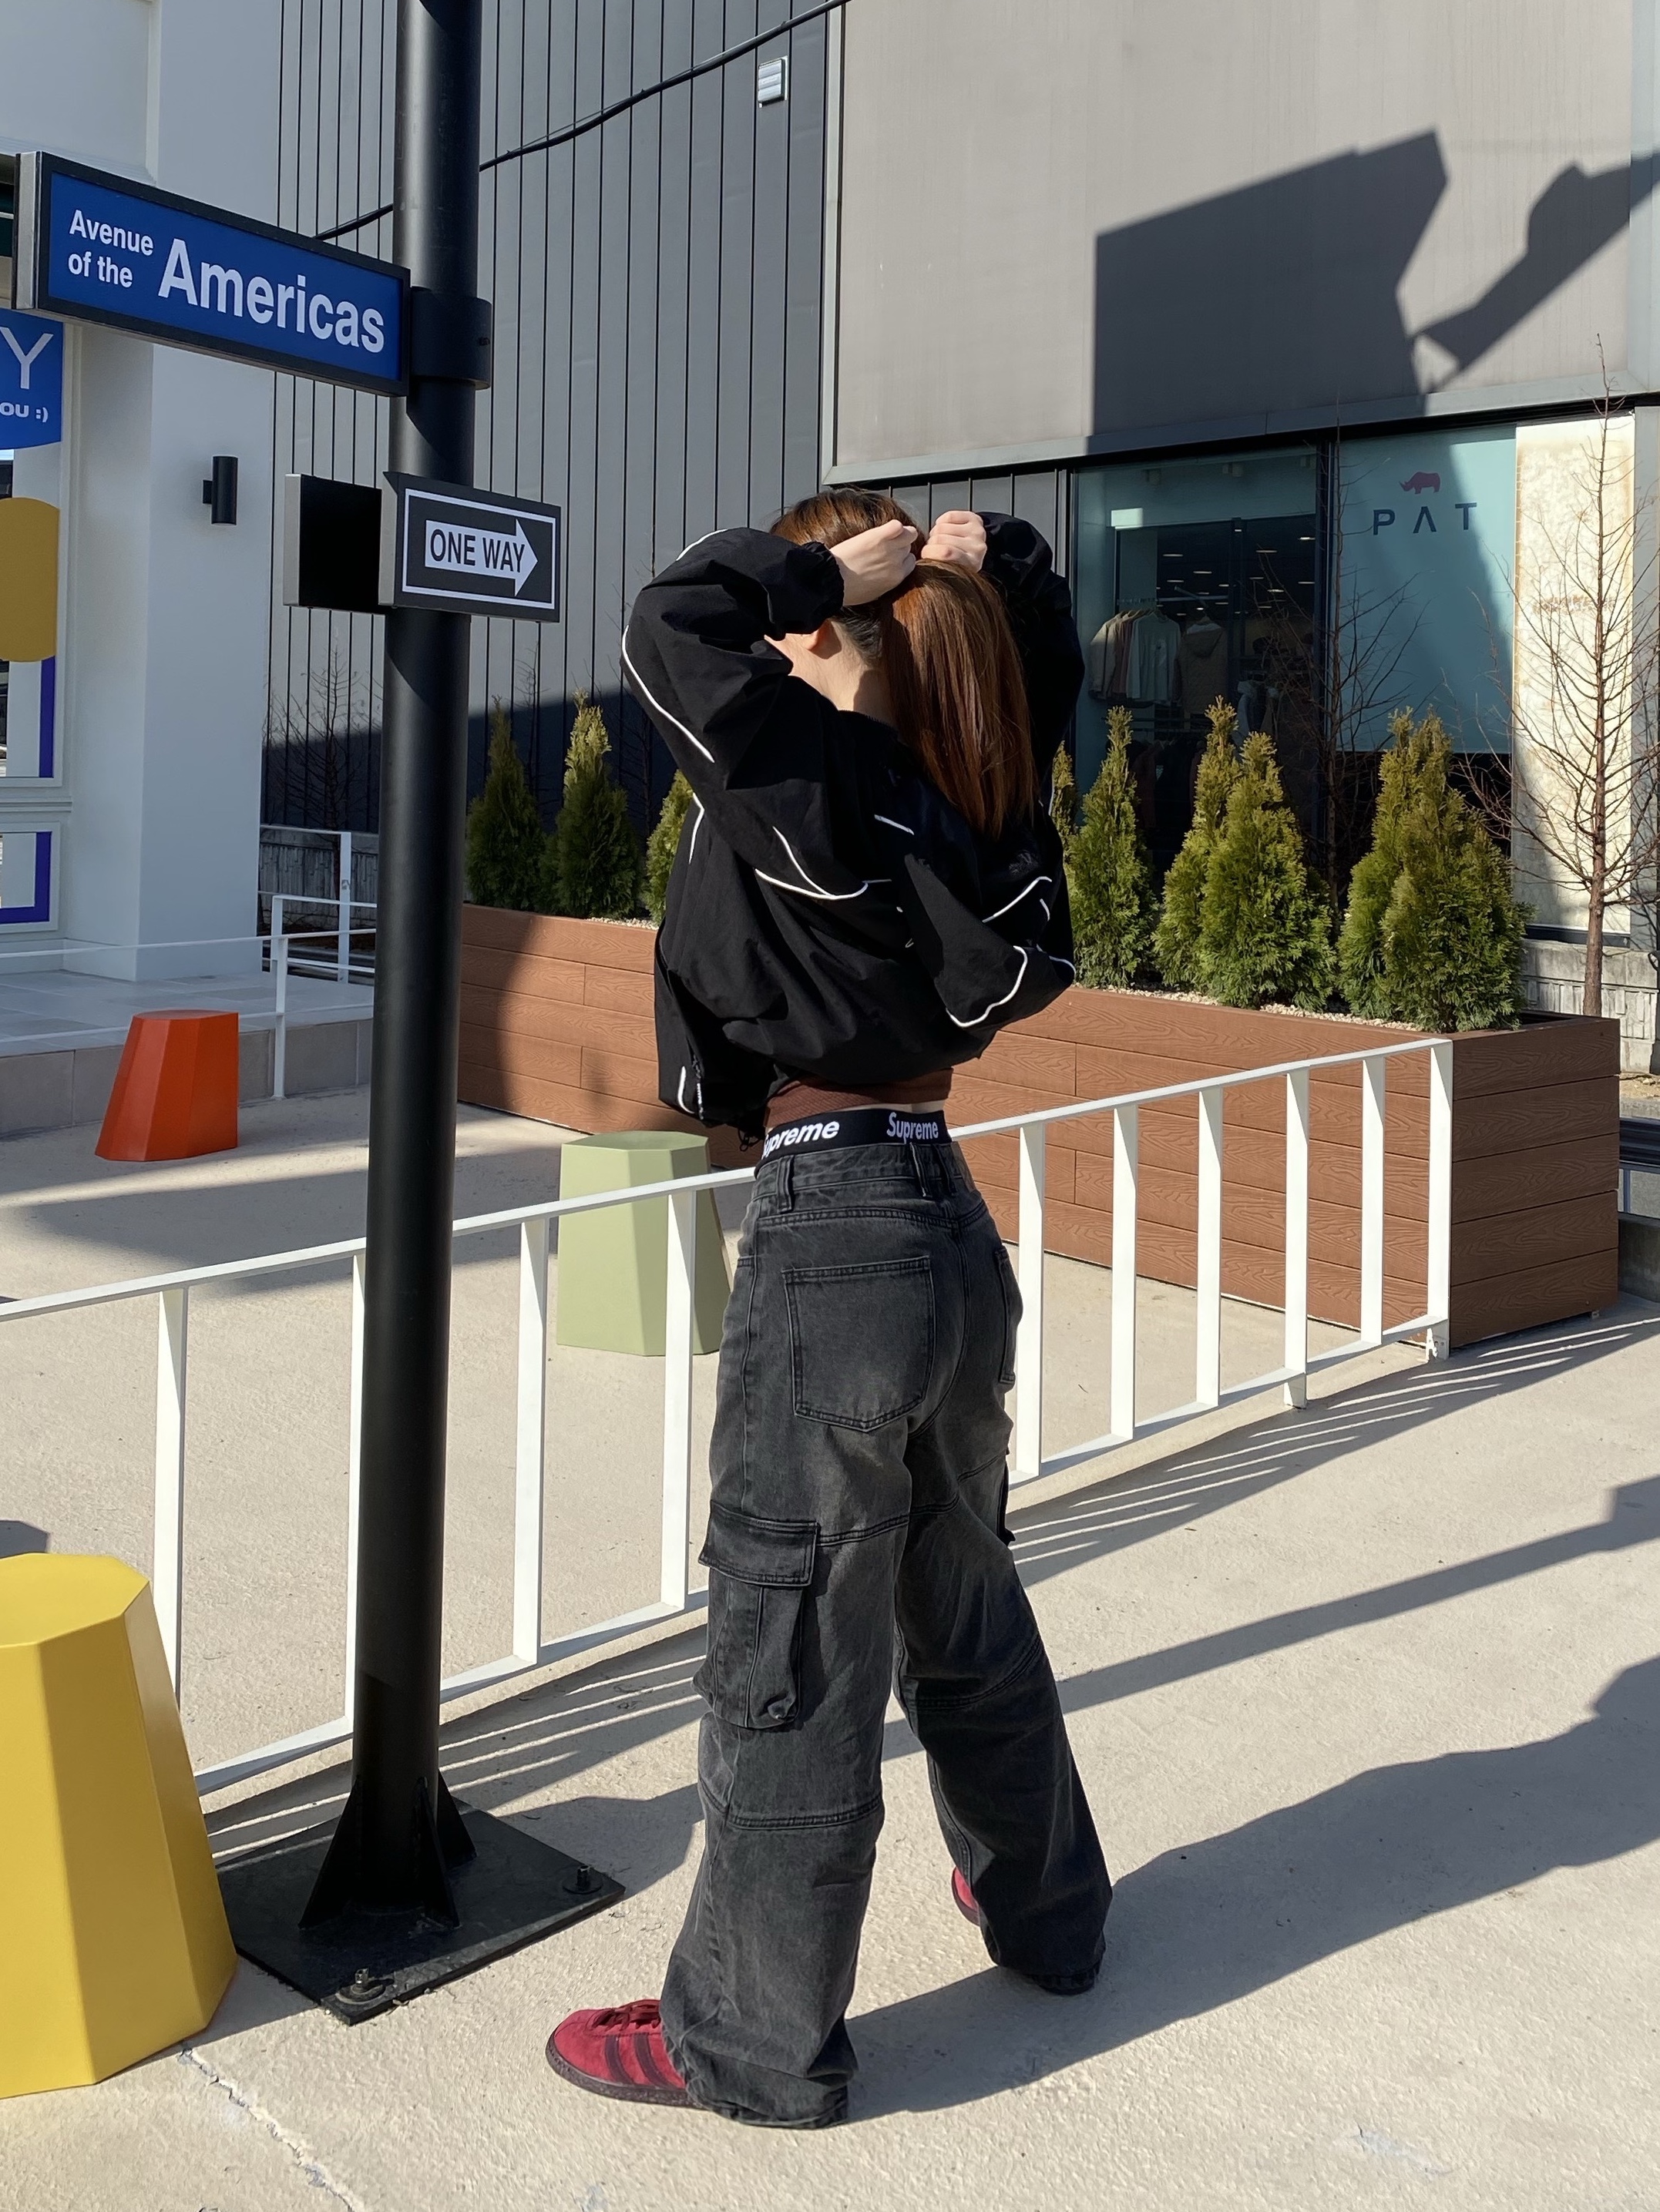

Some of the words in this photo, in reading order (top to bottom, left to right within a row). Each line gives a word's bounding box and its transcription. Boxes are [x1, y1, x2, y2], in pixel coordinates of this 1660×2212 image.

[69, 210, 154, 257] Avenue
[68, 251, 94, 278] of
[98, 257, 133, 288] the
[158, 238, 385, 354] Americas
[429, 529, 476, 567] ONE
[482, 535, 526, 573] WAY
[886, 1112, 939, 1144] Supreme
